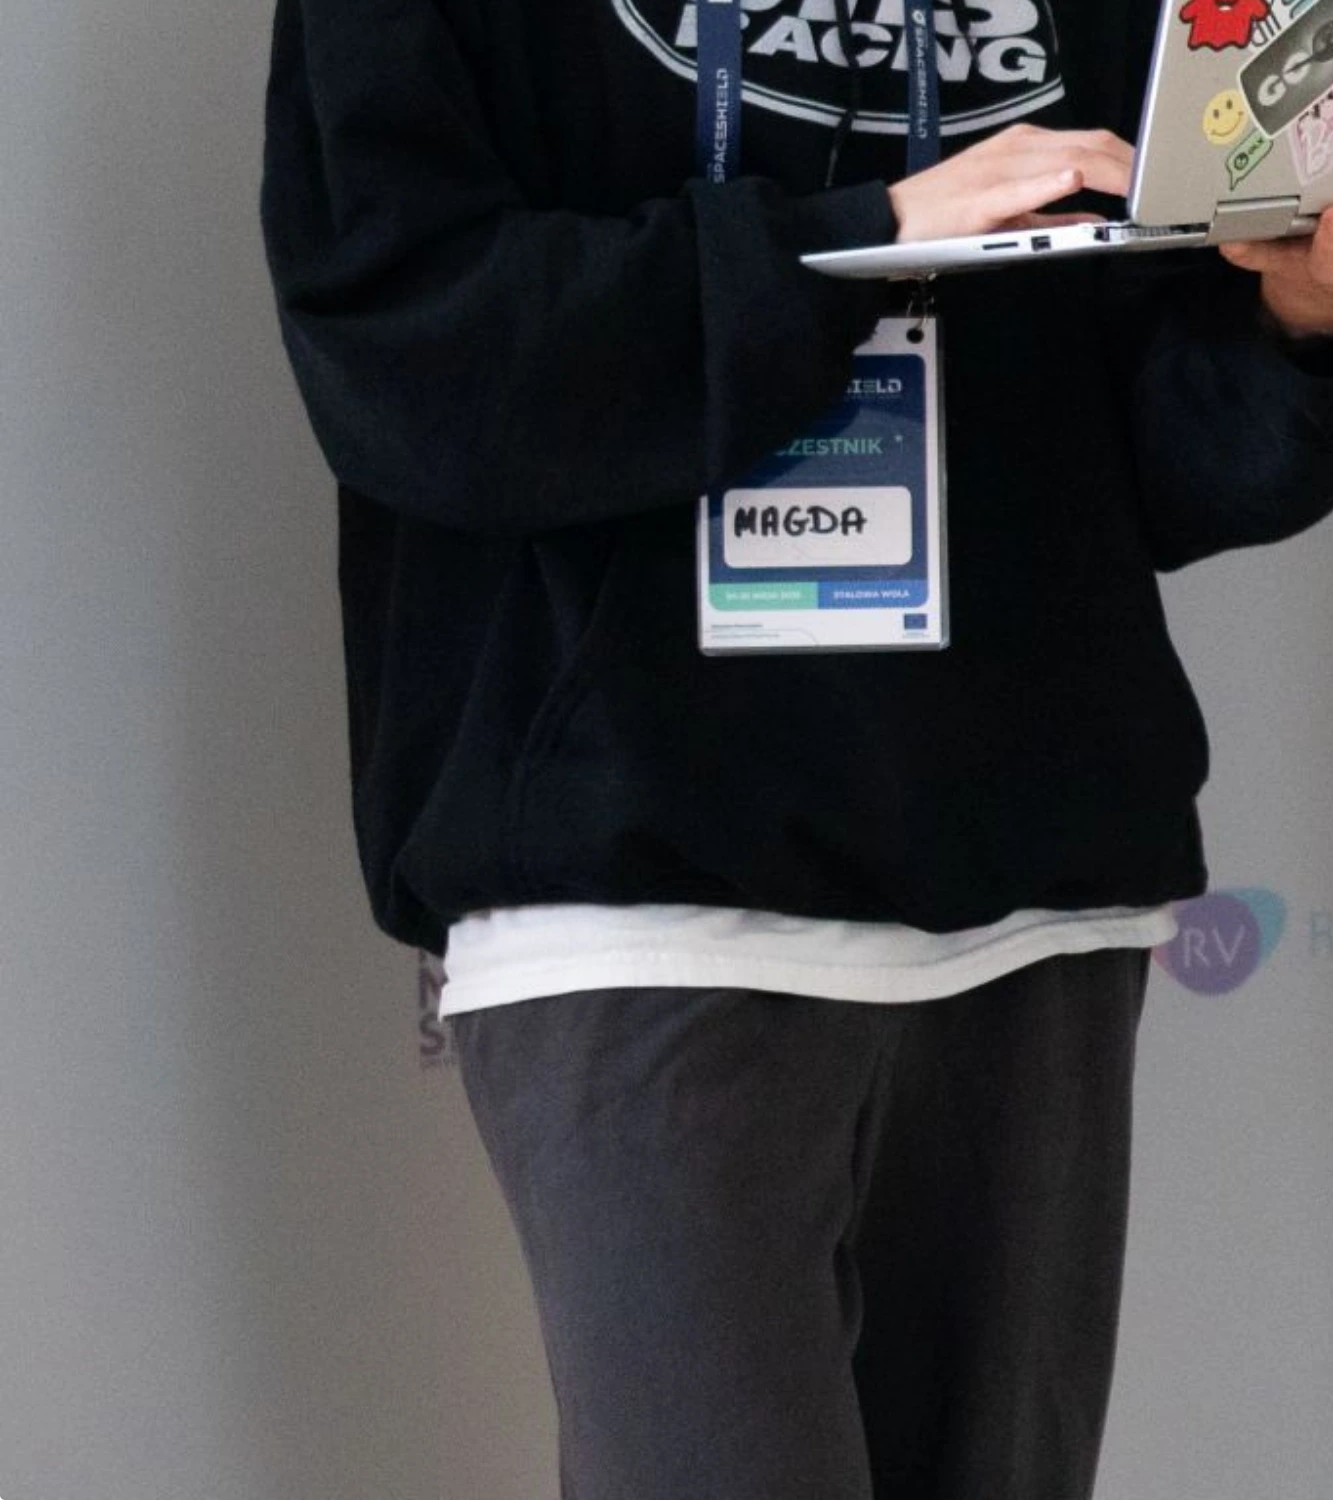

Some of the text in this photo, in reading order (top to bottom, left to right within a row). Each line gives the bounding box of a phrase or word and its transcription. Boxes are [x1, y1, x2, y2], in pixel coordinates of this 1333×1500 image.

[713, 68, 730, 184] SPACESHIELD
[733, 504, 869, 538] MAGDA
[1182, 924, 1247, 971] RV
